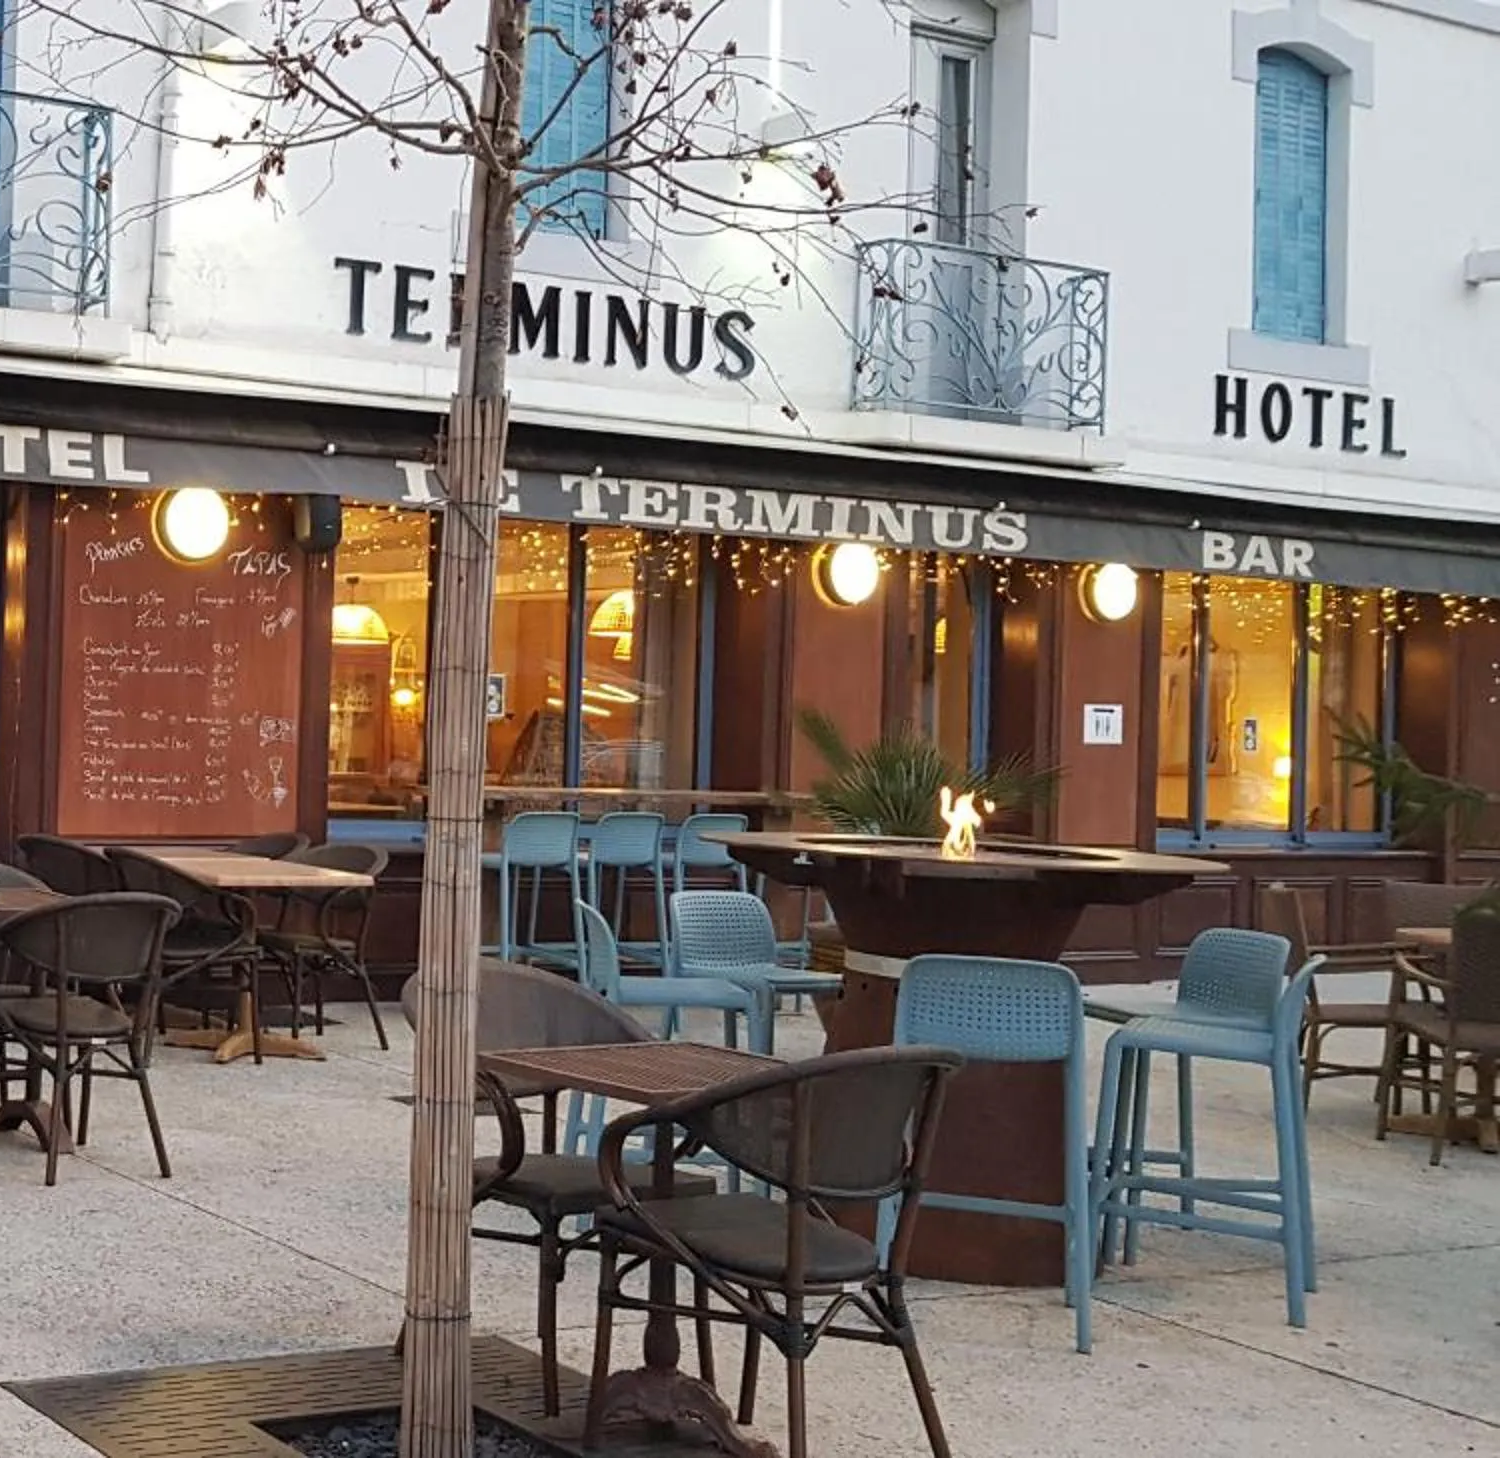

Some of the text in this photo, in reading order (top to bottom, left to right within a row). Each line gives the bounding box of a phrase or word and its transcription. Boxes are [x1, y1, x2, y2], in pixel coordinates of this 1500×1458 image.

[334, 257, 756, 380] TEMINUS
[1213, 373, 1407, 458] HOTEL
[561, 472, 1030, 553] TERMINUS
[1202, 530, 1315, 578] BAR
